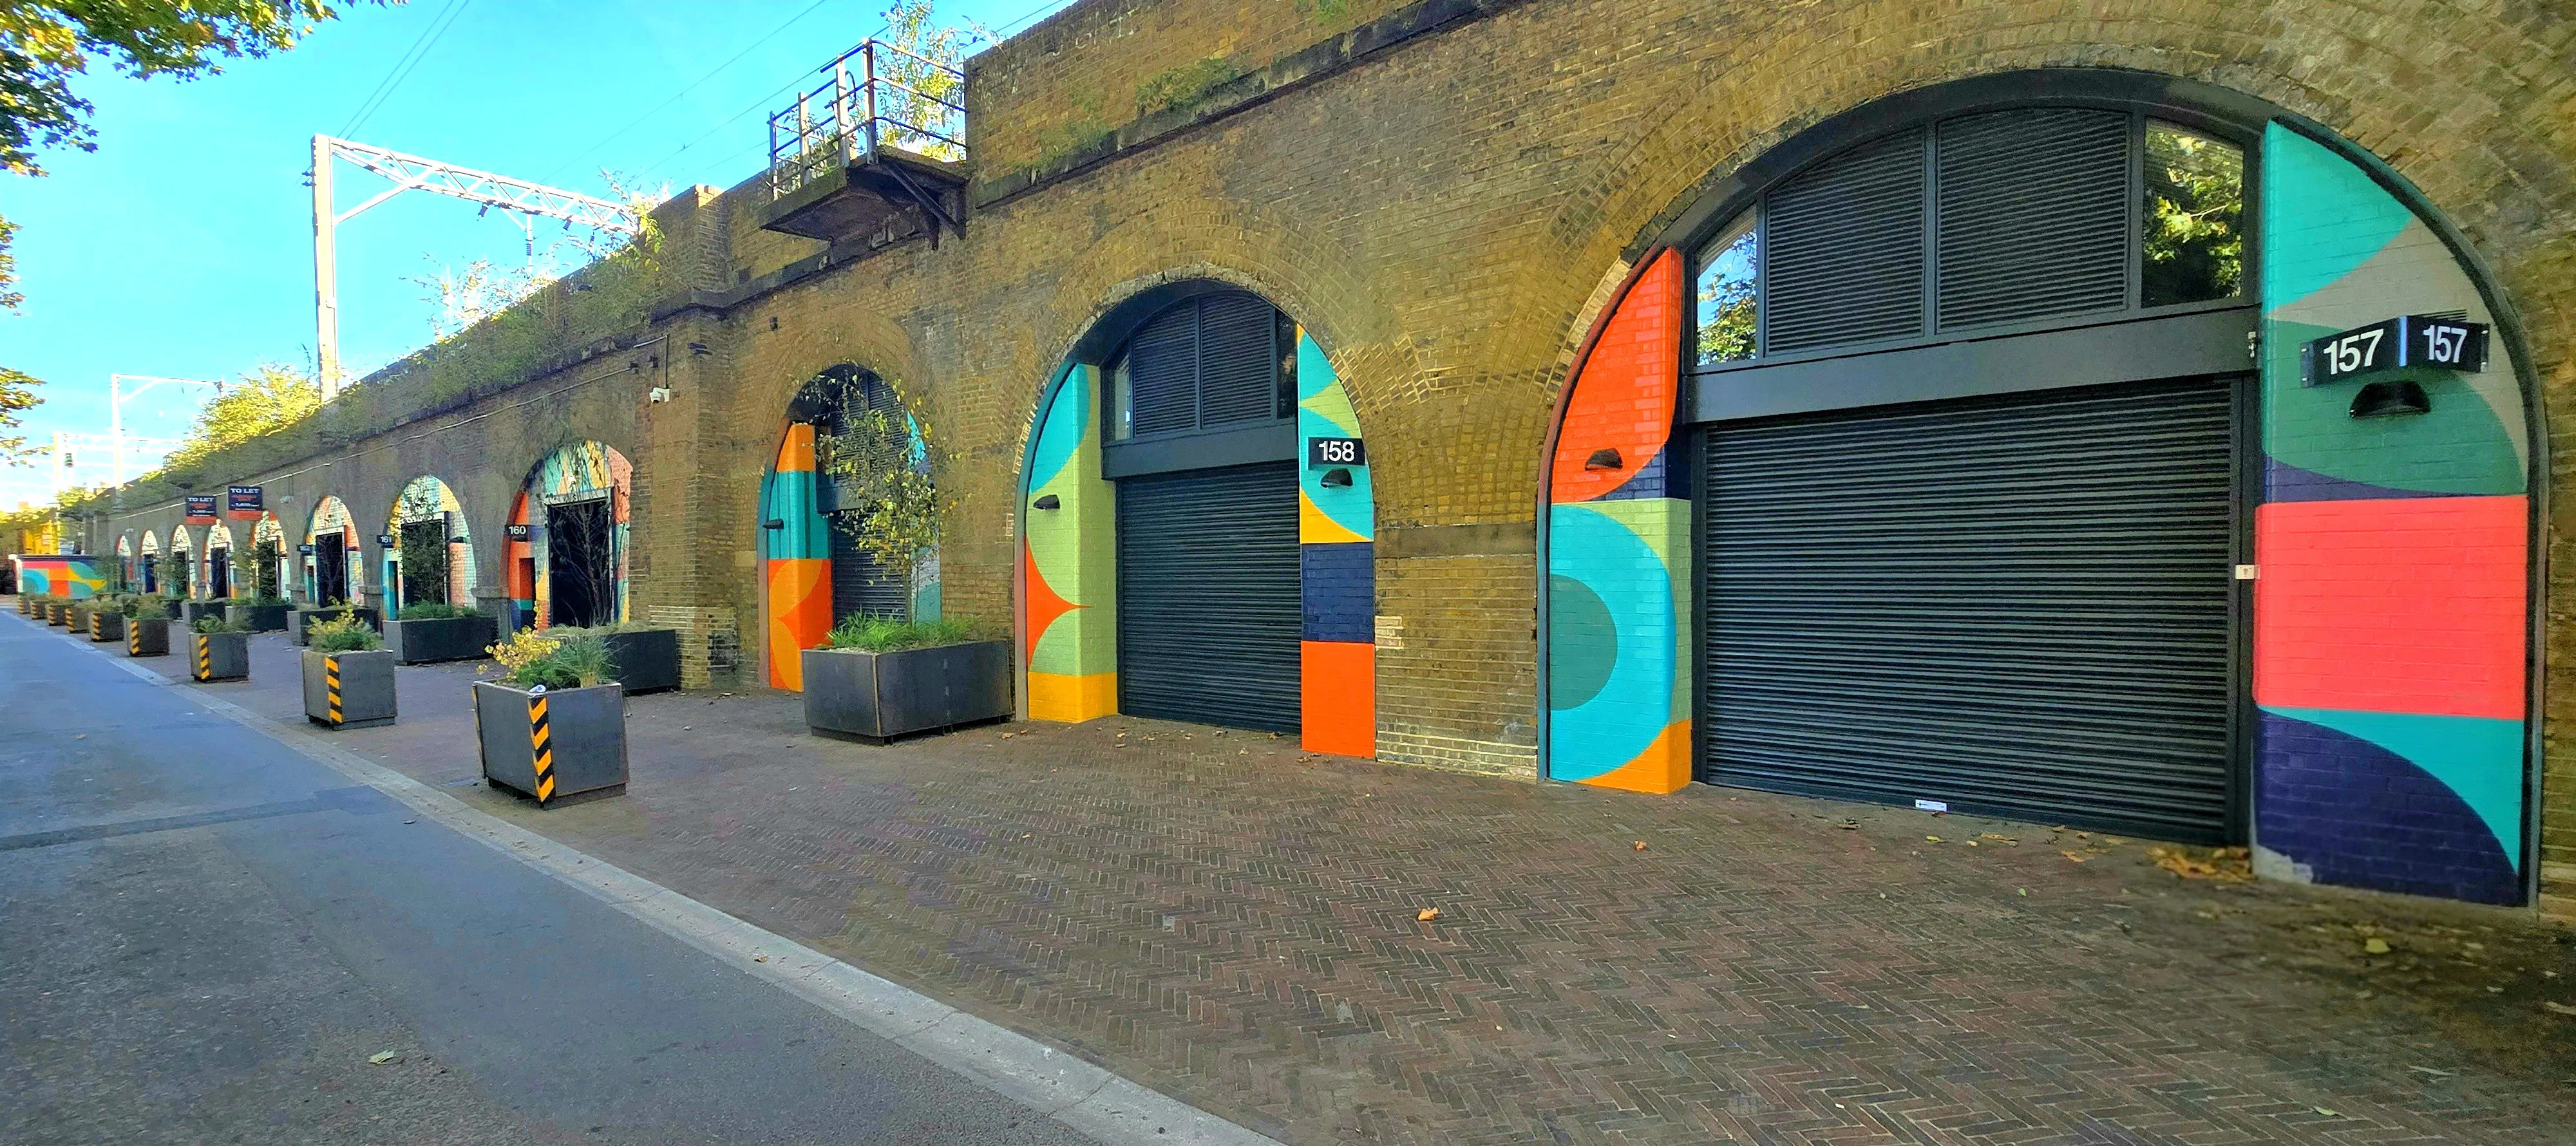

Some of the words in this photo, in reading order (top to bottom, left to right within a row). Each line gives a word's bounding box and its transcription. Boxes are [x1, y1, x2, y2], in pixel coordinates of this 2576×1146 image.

[2323, 328, 2384, 375] 157
[2423, 324, 2468, 363] 157
[1318, 440, 1355, 462] 158
[508, 525, 527, 535] 160
